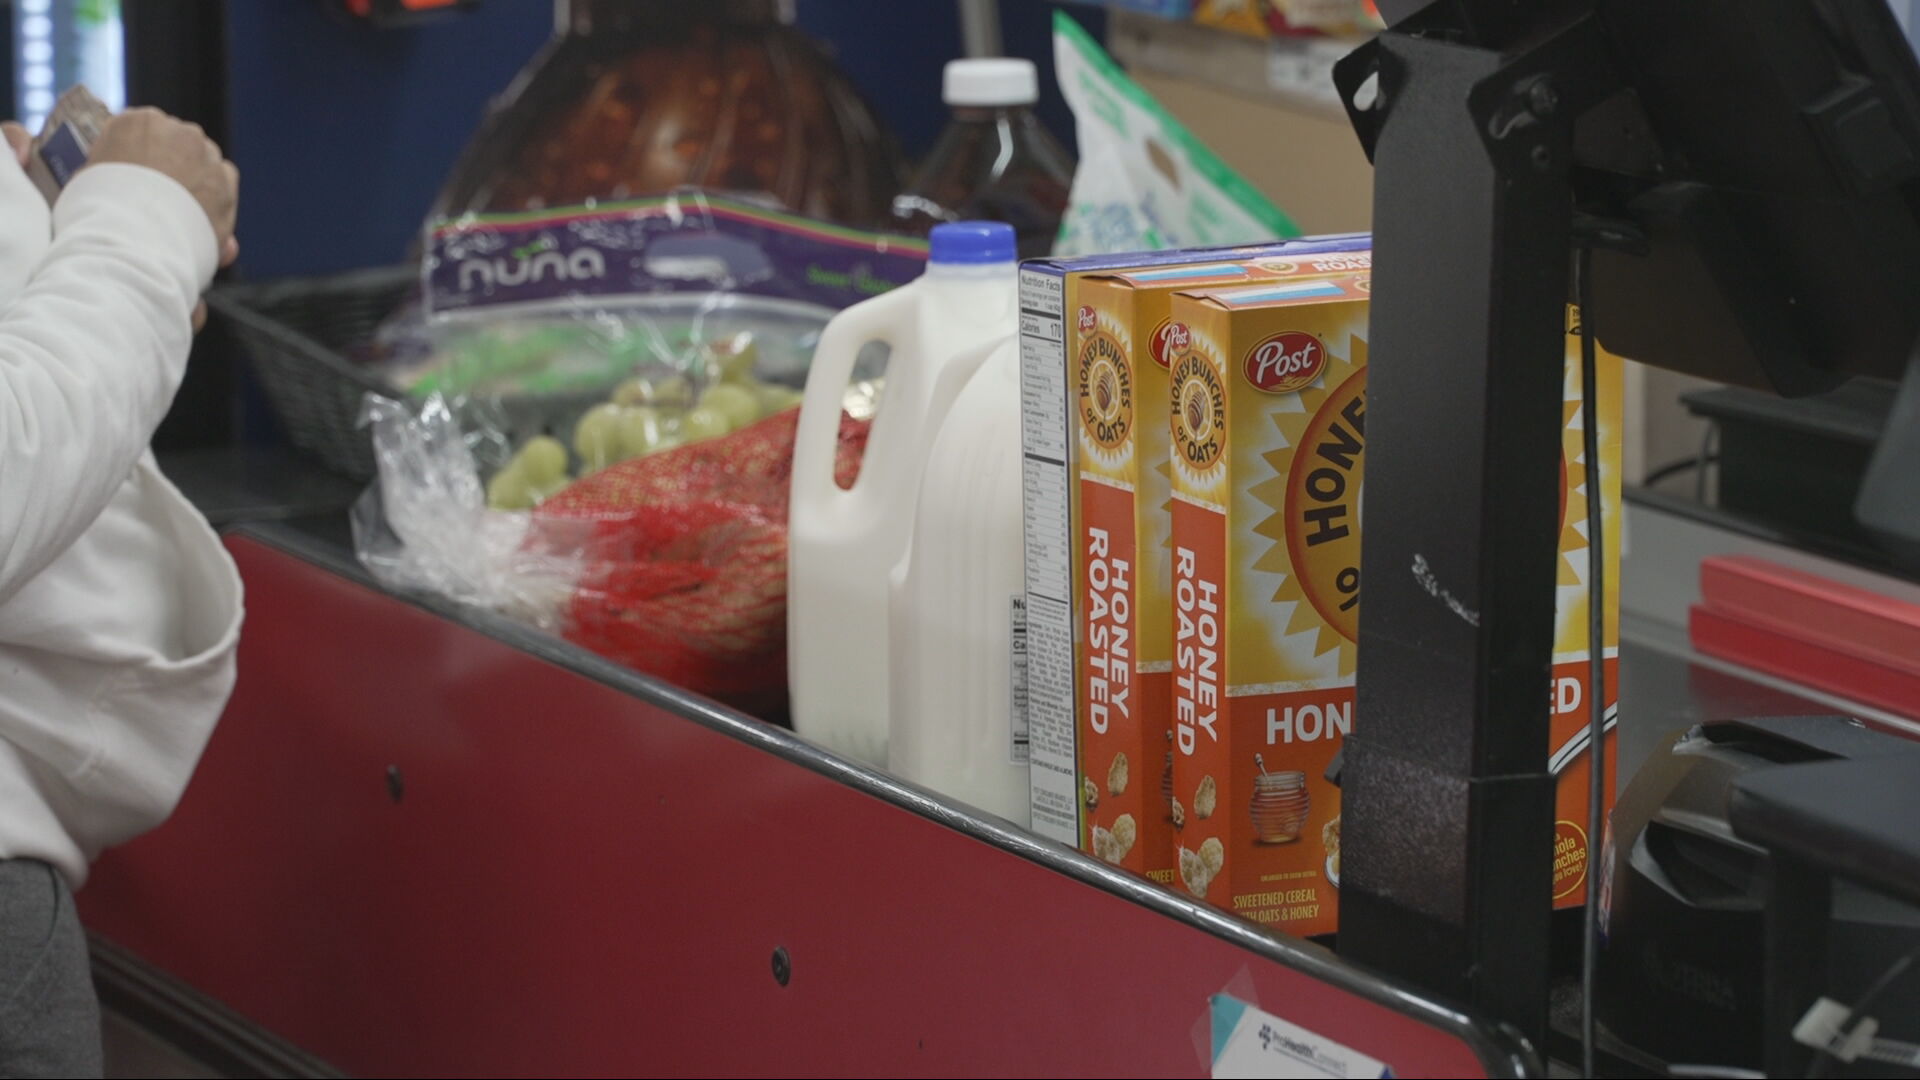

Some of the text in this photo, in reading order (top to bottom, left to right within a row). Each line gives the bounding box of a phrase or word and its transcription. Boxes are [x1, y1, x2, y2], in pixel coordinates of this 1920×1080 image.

[1312, 260, 1371, 272] ROAS
[1078, 307, 1095, 329] Post
[1170, 324, 1188, 345] Post
[1080, 339, 1097, 397] HONEY
[1099, 337, 1131, 409] BUNCHES
[1256, 340, 1314, 386] Post
[1172, 356, 1224, 430] HONEY BUNCHES
[1097, 415, 1126, 443] OATS
[1187, 436, 1218, 463] OATS
[1088, 526, 1109, 735] ROASTED
[1111, 558, 1129, 719] HONEY
[1176, 546, 1196, 757] ROASTED
[1198, 579, 1218, 743] HONEY
[1266, 701, 1352, 745] HON
[1553, 847, 1586, 871] nches
[1146, 869, 1175, 883] SWEET
[1233, 888, 1317, 910] SWEETENED CEREAL
[1259, 908, 1280, 923] OATS
[1281, 907, 1289, 921] &
[1290, 905, 1320, 920] HONEY
